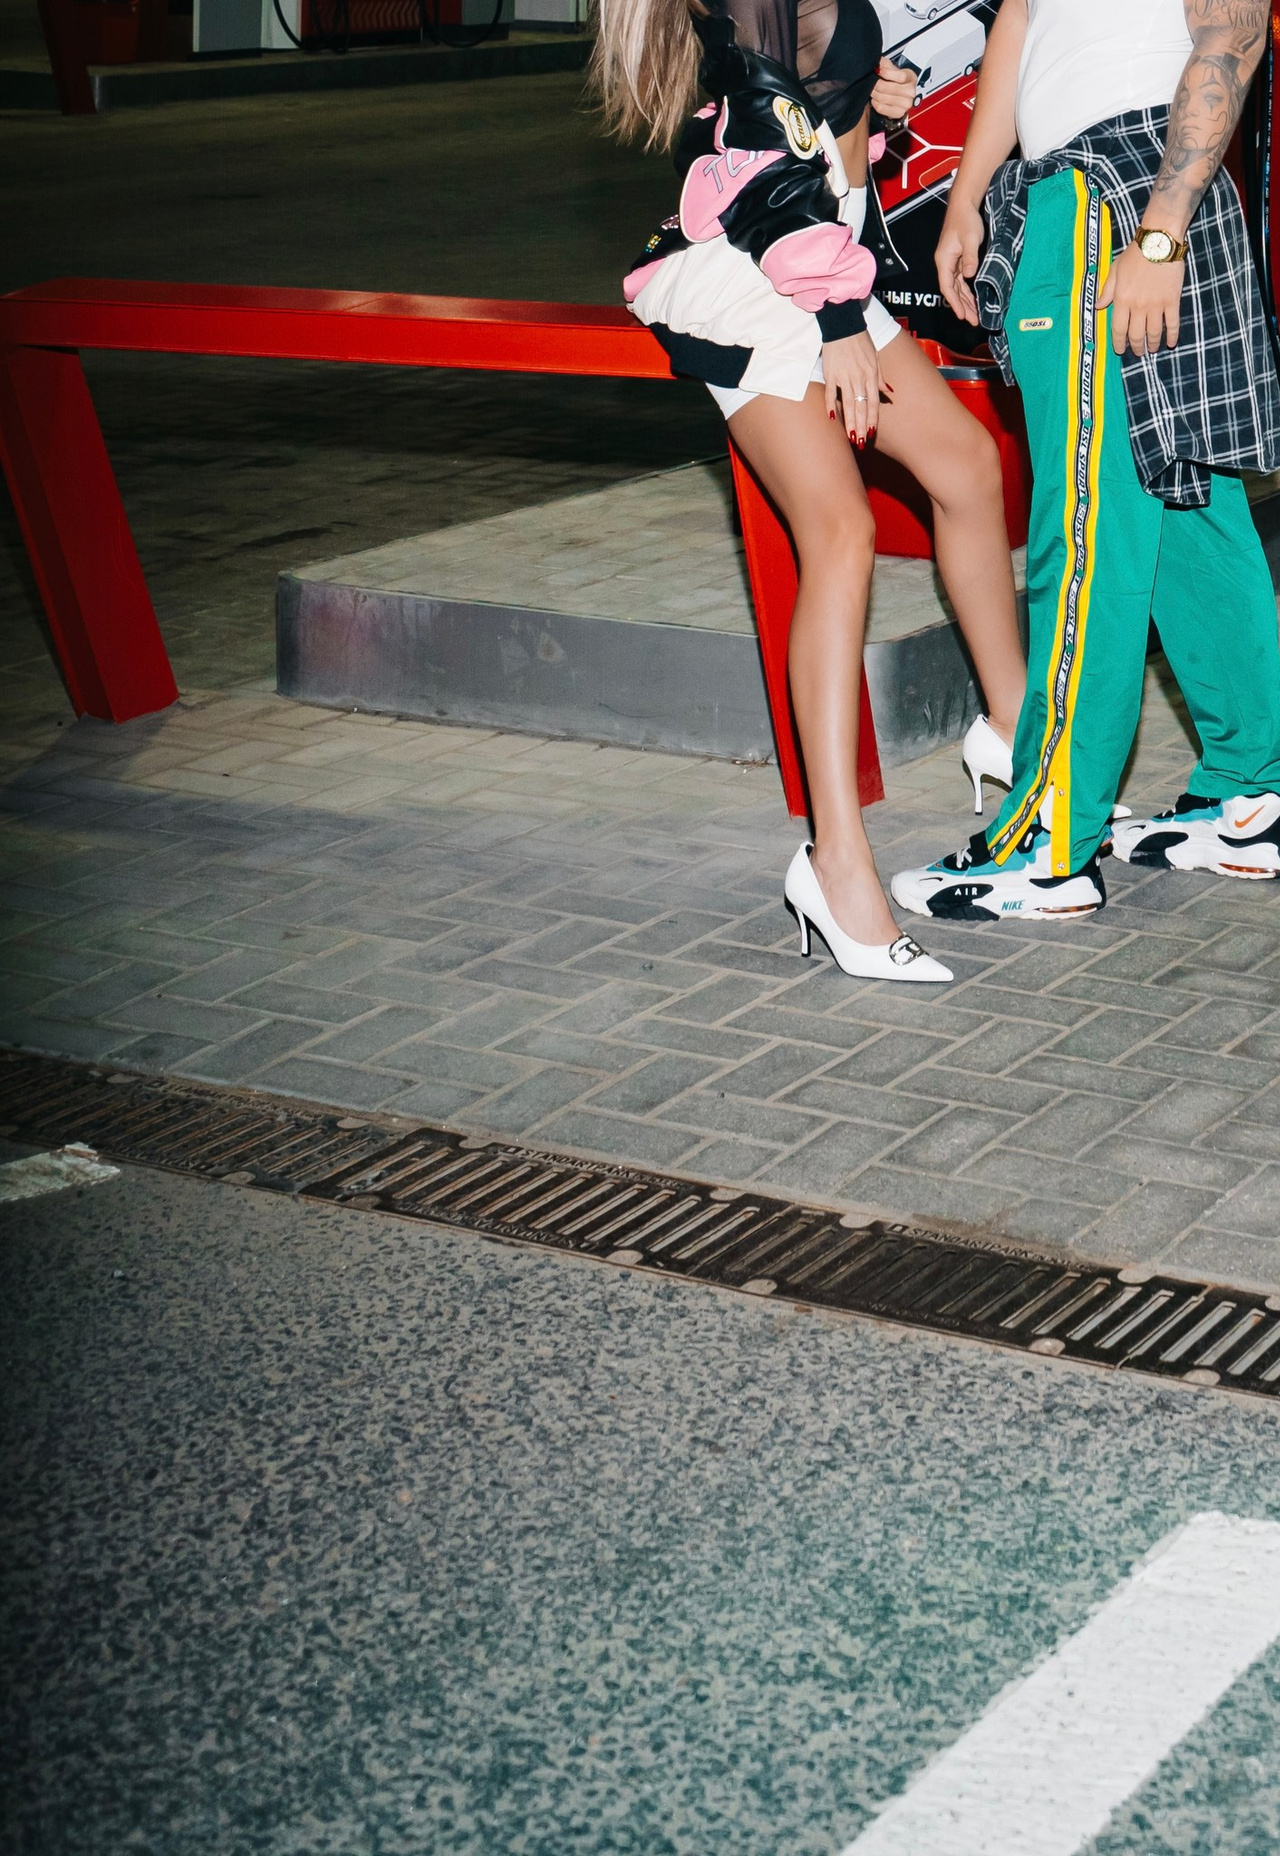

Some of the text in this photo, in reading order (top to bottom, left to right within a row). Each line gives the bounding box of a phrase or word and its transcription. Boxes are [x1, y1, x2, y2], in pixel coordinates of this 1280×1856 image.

[1082, 360, 1092, 408] SPORT
[955, 887, 978, 896] AIR
[1001, 900, 1025, 911] NIKE
